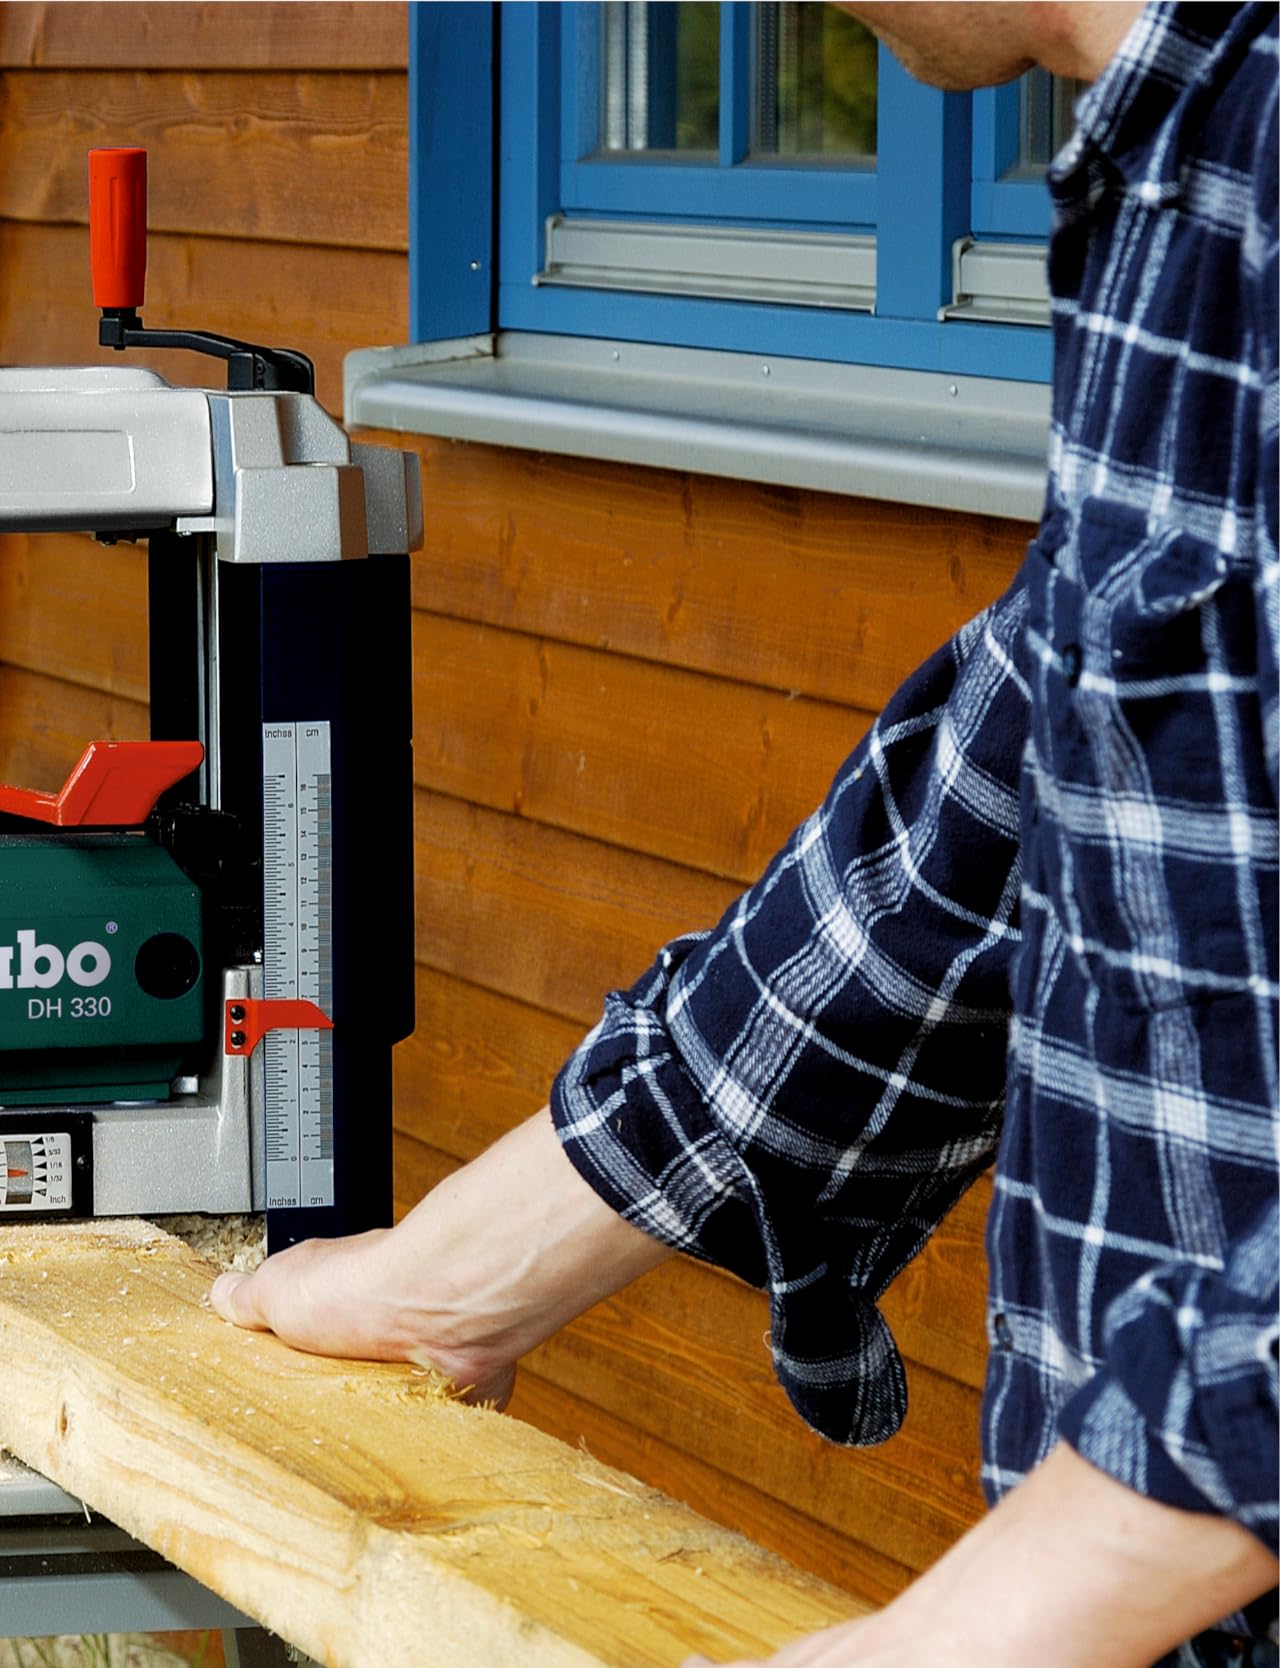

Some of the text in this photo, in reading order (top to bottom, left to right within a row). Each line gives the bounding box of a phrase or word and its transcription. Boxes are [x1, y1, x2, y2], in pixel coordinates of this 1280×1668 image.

[306, 729, 319, 737] cm
[300, 830, 307, 838] 14
[28, 996, 112, 1019] DH 330
[310, 1196, 324, 1204] cm
